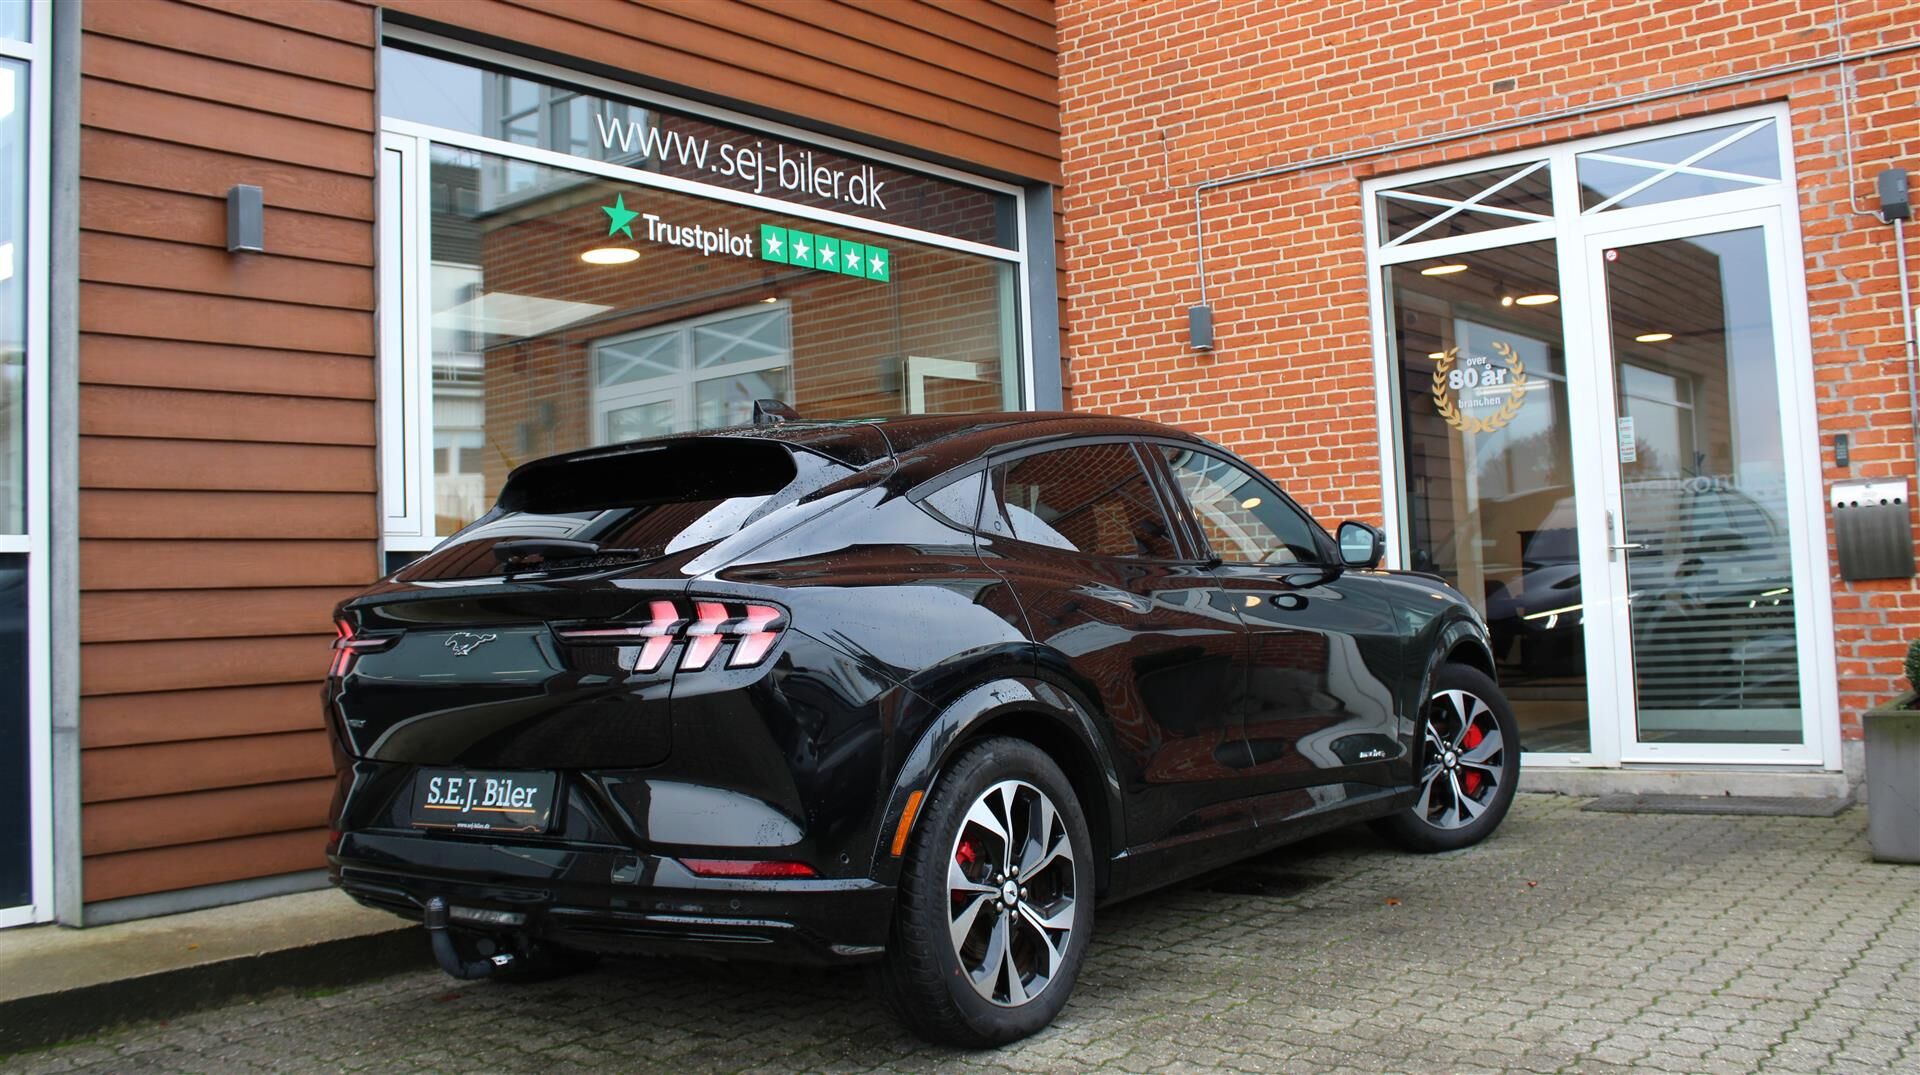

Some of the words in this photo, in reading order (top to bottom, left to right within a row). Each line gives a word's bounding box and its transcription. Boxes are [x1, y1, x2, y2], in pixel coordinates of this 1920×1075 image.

[596, 113, 887, 210] www.sej-biler.dk
[642, 213, 753, 258] Trustpilot
[1449, 368, 1478, 390] 80
[1481, 363, 1507, 386] år
[1466, 356, 1487, 367] over
[1458, 396, 1501, 409] branchen
[427, 777, 477, 813] S.E.J.
[482, 779, 538, 808] Biler
